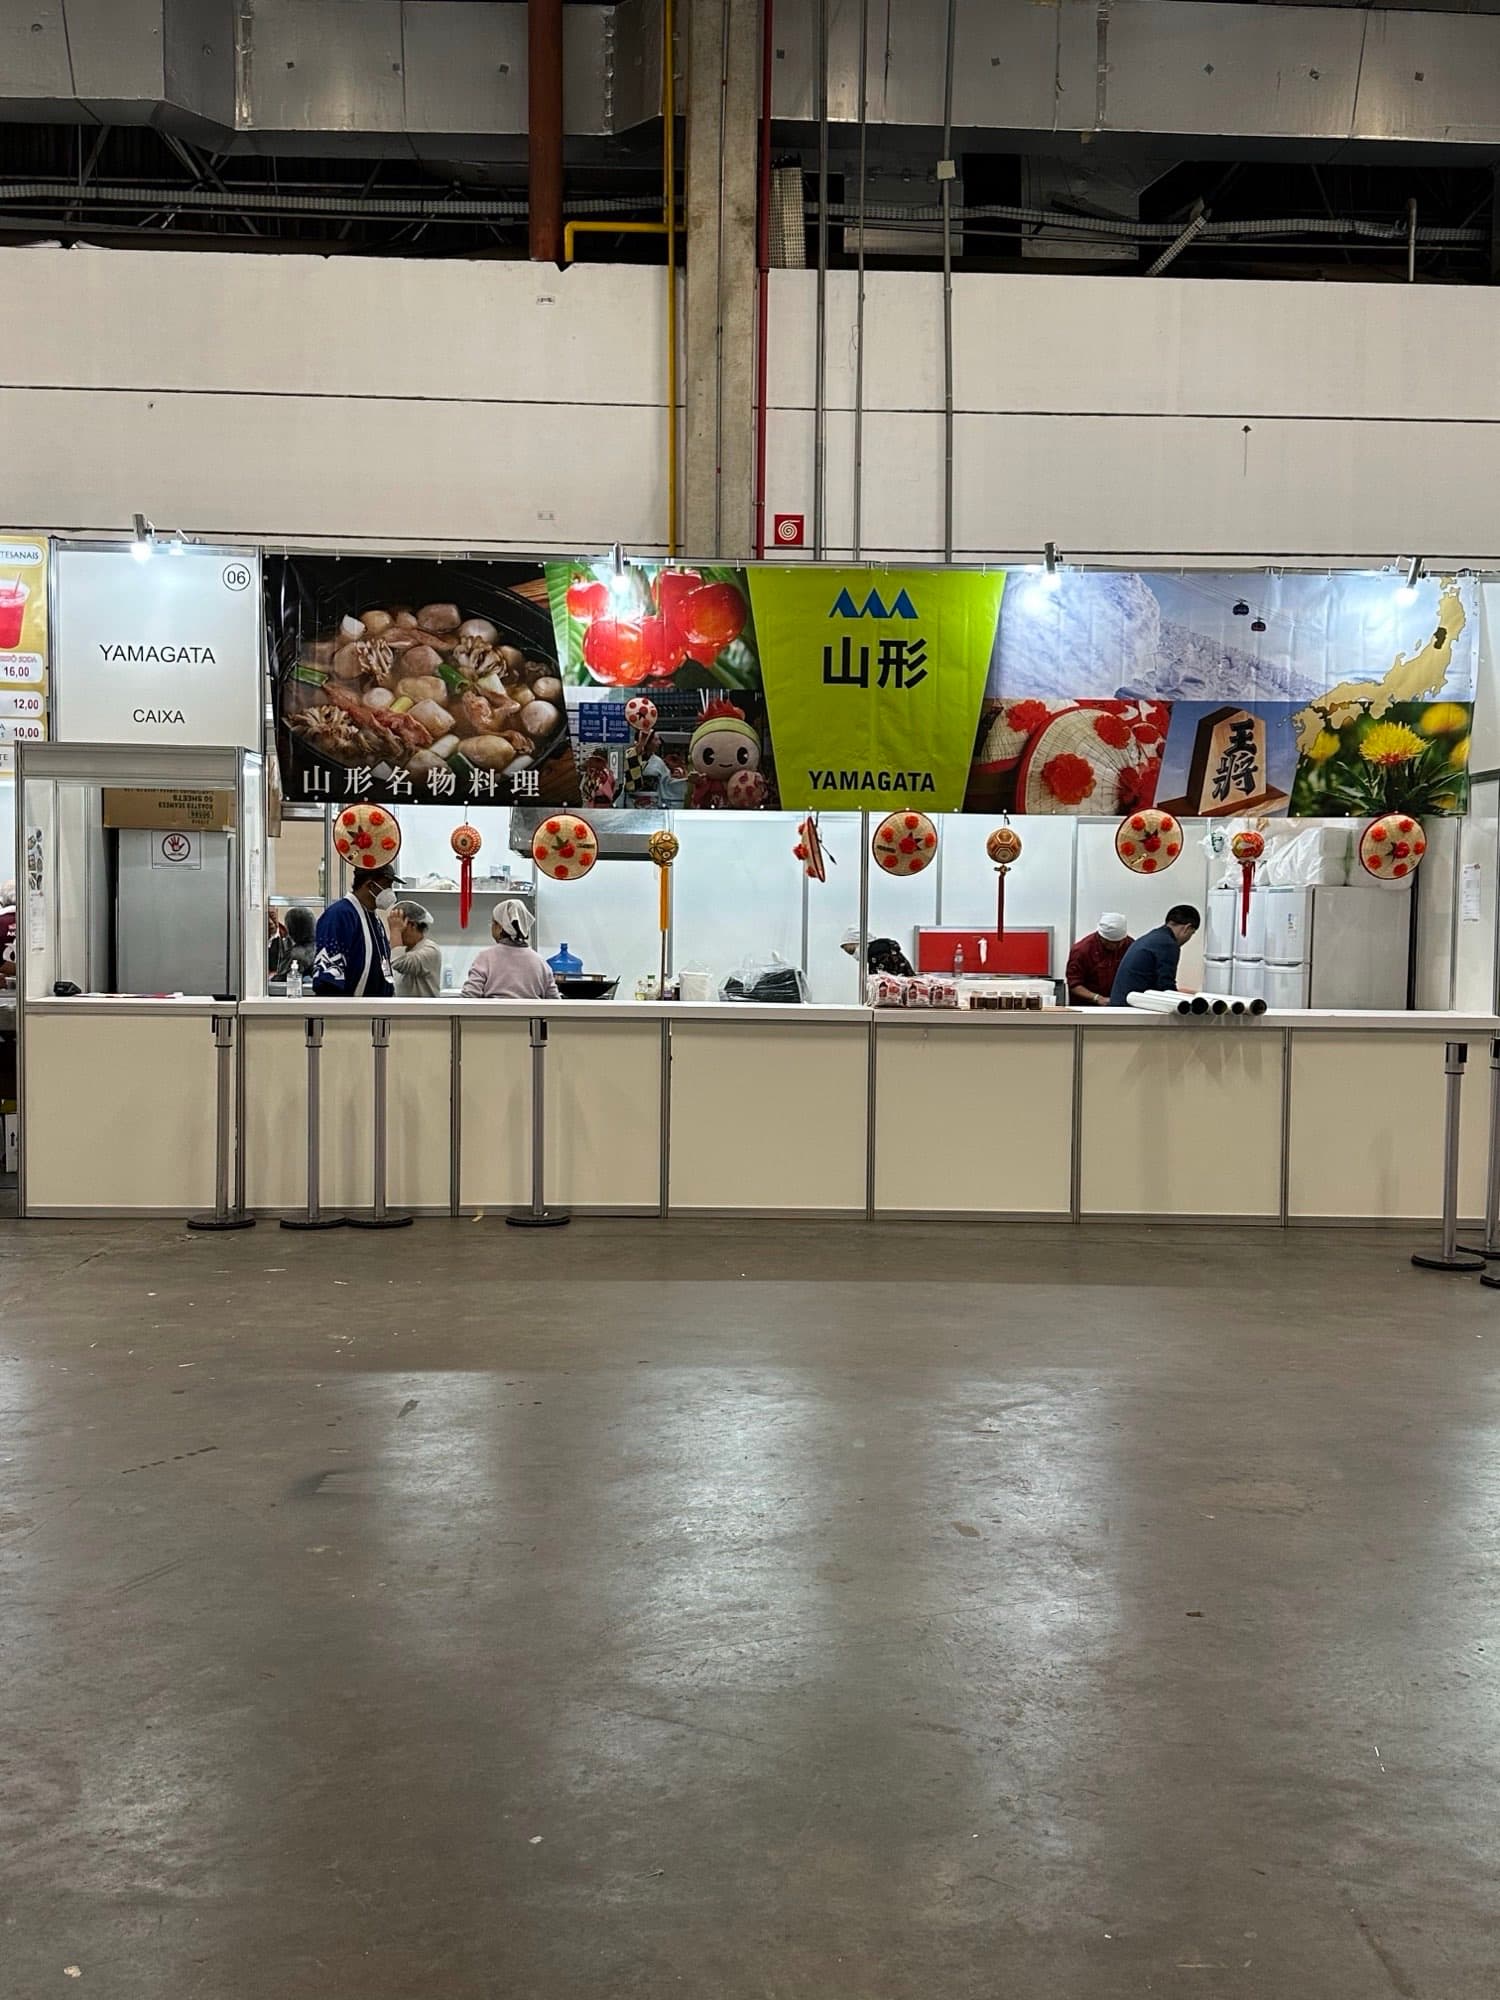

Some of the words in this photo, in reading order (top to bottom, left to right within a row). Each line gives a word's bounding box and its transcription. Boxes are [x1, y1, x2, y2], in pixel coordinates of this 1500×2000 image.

[227, 571, 246, 585] 06
[99, 645, 216, 664] YAMAGATA
[823, 636, 928, 689] 山形
[4, 666, 29, 678] 16,00
[14, 698, 39, 710] 12,00
[133, 709, 185, 723] CAIXA
[14, 727, 39, 739] 10,00
[303, 765, 541, 797] 山形名物料理
[808, 770, 936, 792] YAMAGATA
